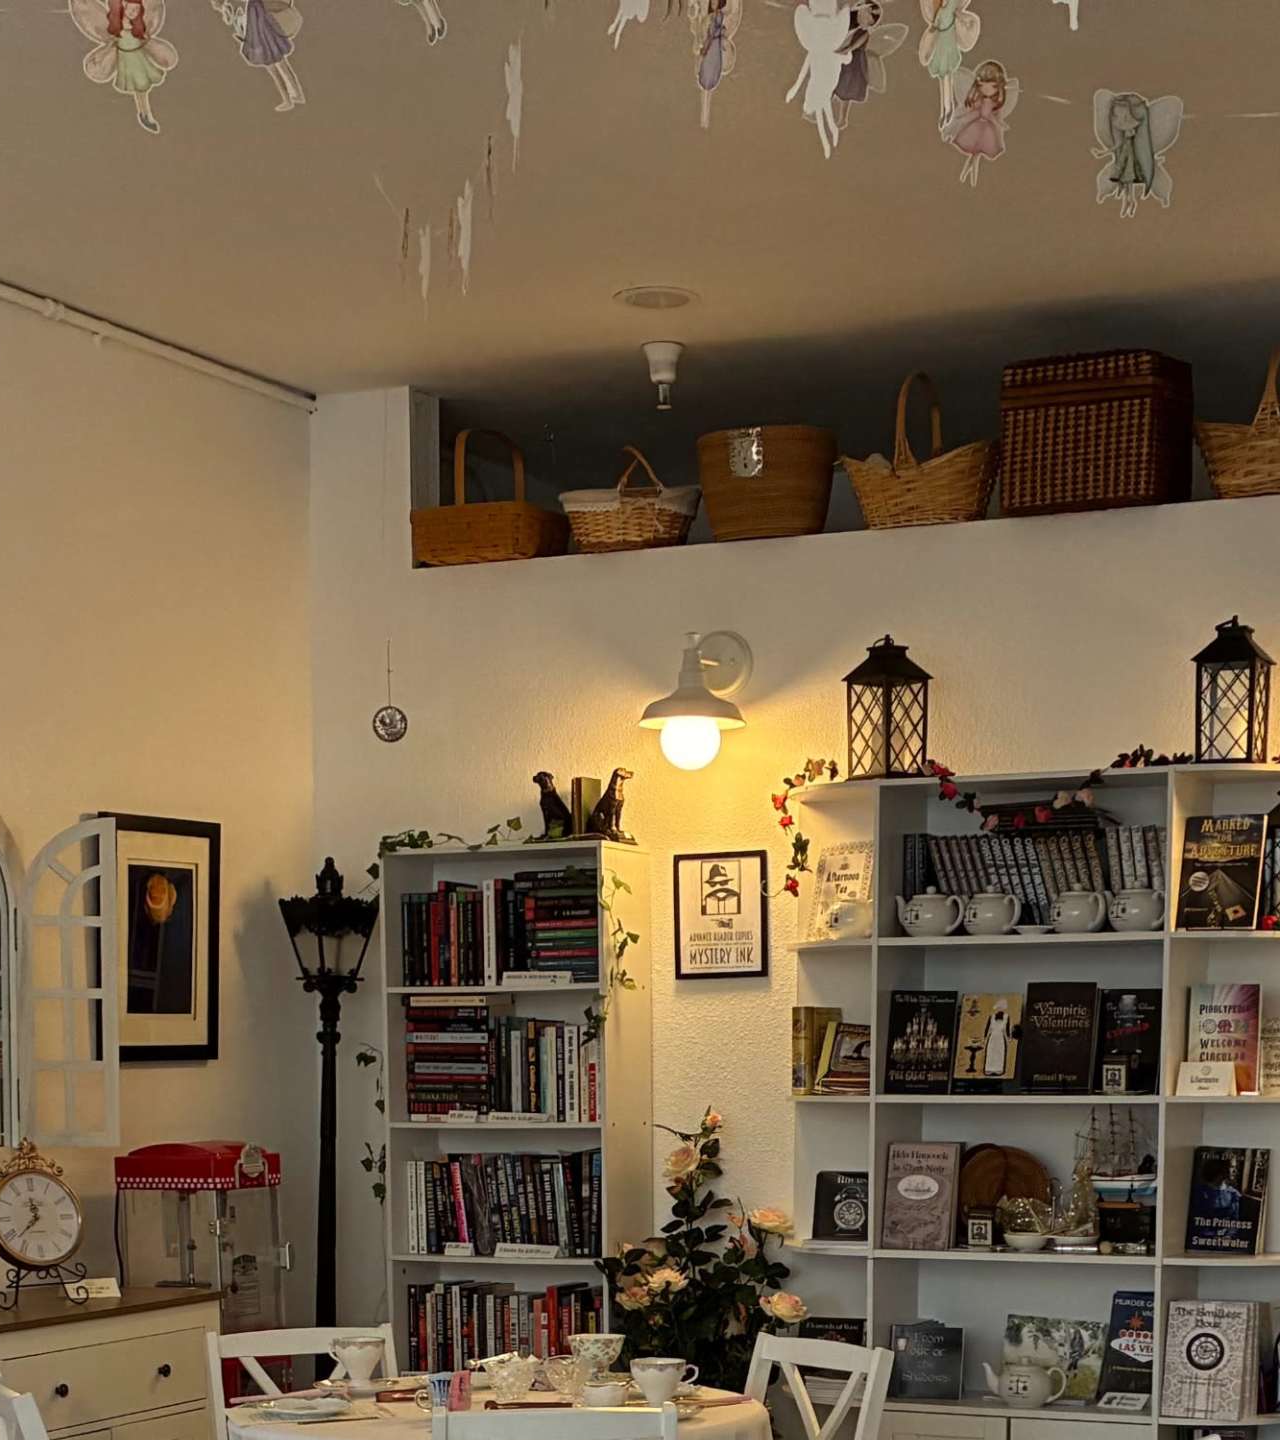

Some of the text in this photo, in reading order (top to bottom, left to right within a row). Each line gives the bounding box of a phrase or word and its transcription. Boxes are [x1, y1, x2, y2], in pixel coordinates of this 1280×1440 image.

[1200, 819, 1251, 833] MARKED
[826, 871, 861, 883] Afternoon
[689, 946, 754, 965] MYSTERY INK
[1194, 1217, 1253, 1230] The Princess
[1175, 1306, 1193, 1317] The
[1119, 1343, 1137, 1353] LAS
